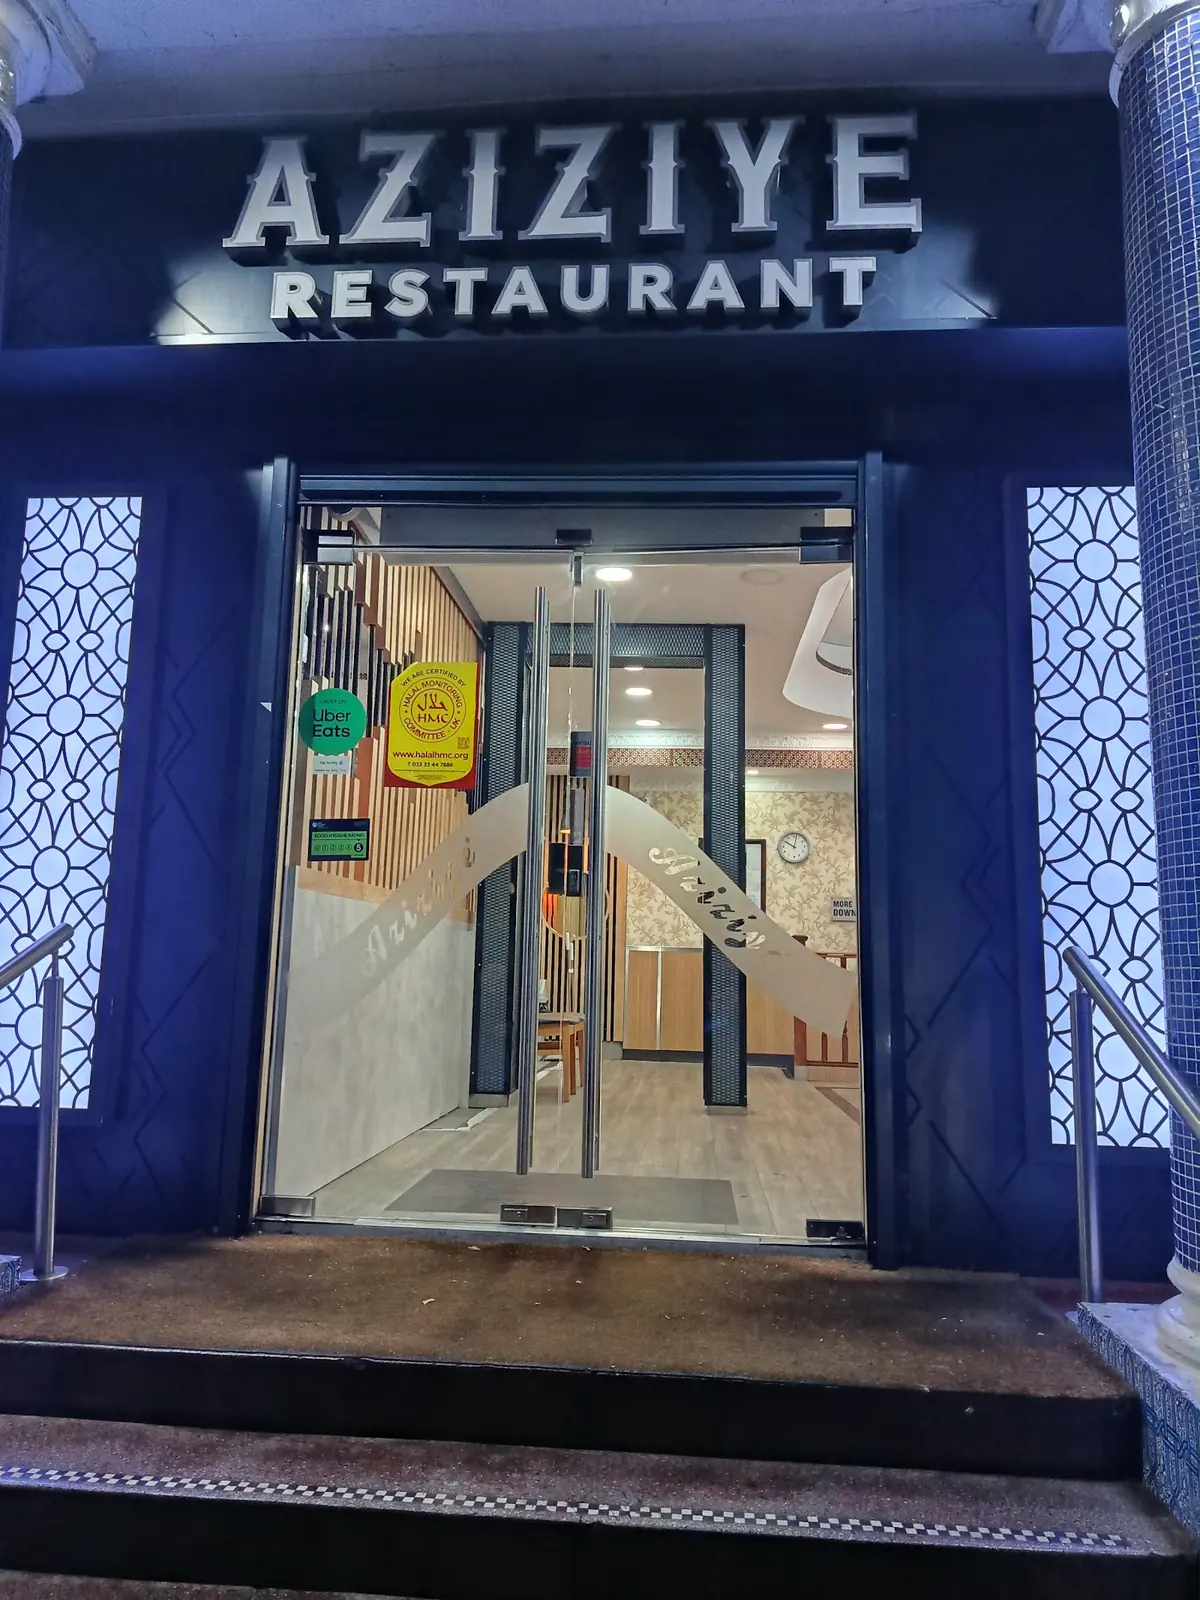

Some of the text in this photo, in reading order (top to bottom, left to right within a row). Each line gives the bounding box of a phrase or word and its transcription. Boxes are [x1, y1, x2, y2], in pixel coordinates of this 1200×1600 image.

[222, 114, 922, 248] AZIZIYE
[270, 256, 877, 319] RESTAURANT
[401, 668, 466, 687] WE ARE CERTIFIED BY
[403, 680, 463, 708] HALAL MONITORING
[312, 708, 351, 722] Uber
[417, 713, 448, 723] HMC
[312, 724, 350, 737] Eats
[403, 717, 447, 740] COMMITTEE
[449, 718, 461, 730] UK
[393, 751, 469, 760] www.halalhmc.org
[649, 848, 783, 956] Aziziy
[833, 900, 853, 908] MORE
